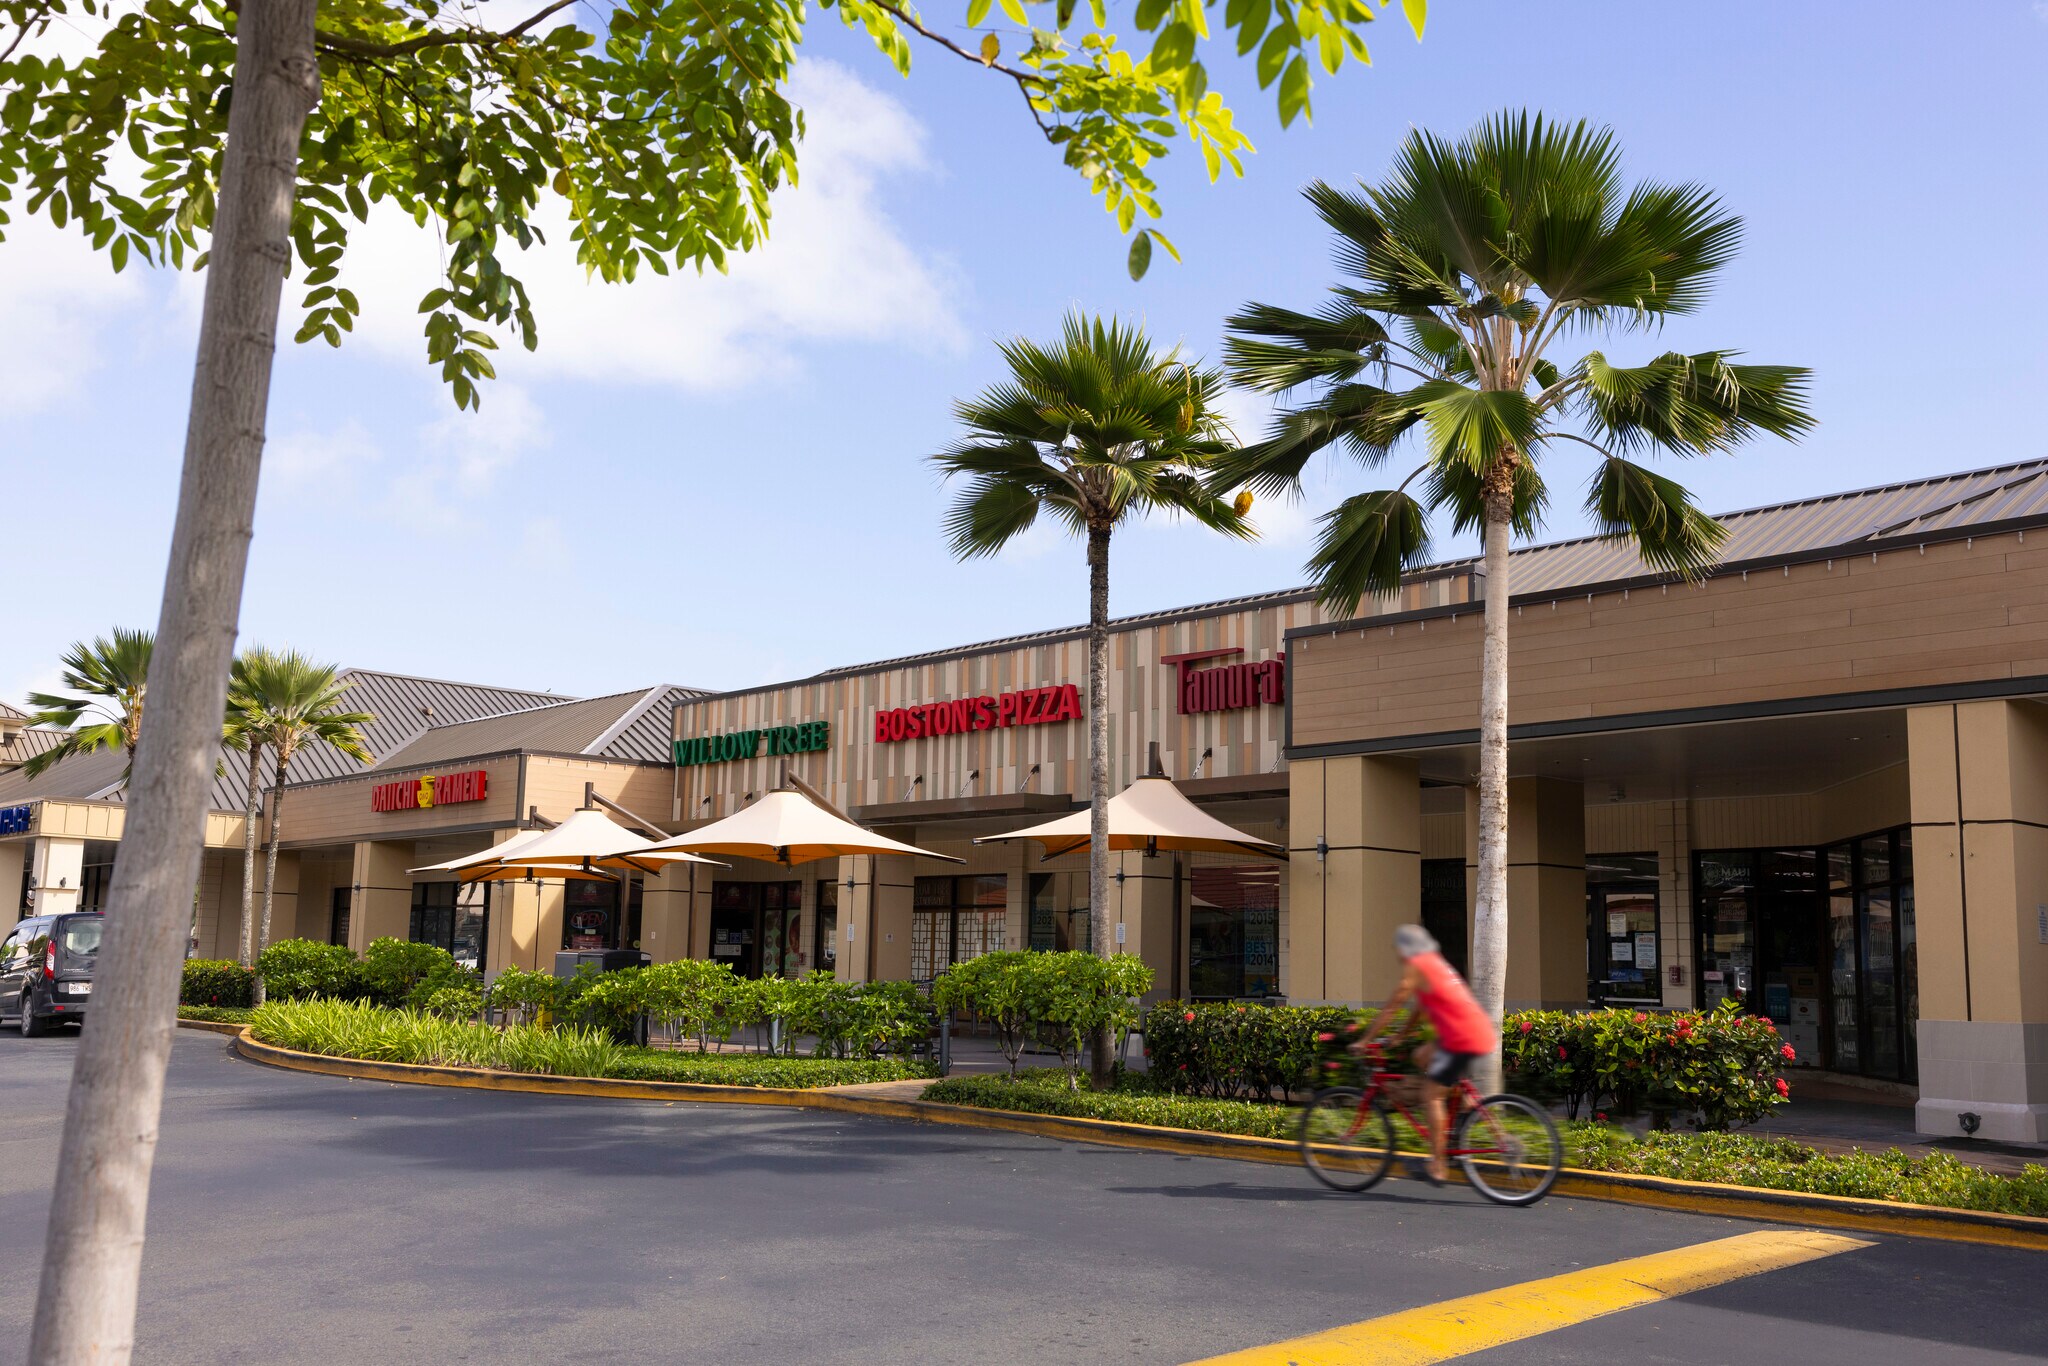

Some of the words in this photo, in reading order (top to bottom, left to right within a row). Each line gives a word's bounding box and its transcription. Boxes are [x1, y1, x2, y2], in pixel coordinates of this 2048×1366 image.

[875, 695, 997, 744] BOSTON'S
[1000, 683, 1083, 729] PIZZA
[673, 729, 762, 767] WILLOW
[762, 721, 829, 757] TREE
[371, 779, 420, 812] DAIICHI
[433, 770, 487, 805] RAMEN
[571, 911, 605, 926] OPEN
[1250, 912, 1273, 925] 2015
[1245, 942, 1273, 954] BEST
[1250, 954, 1274, 966] 2014
